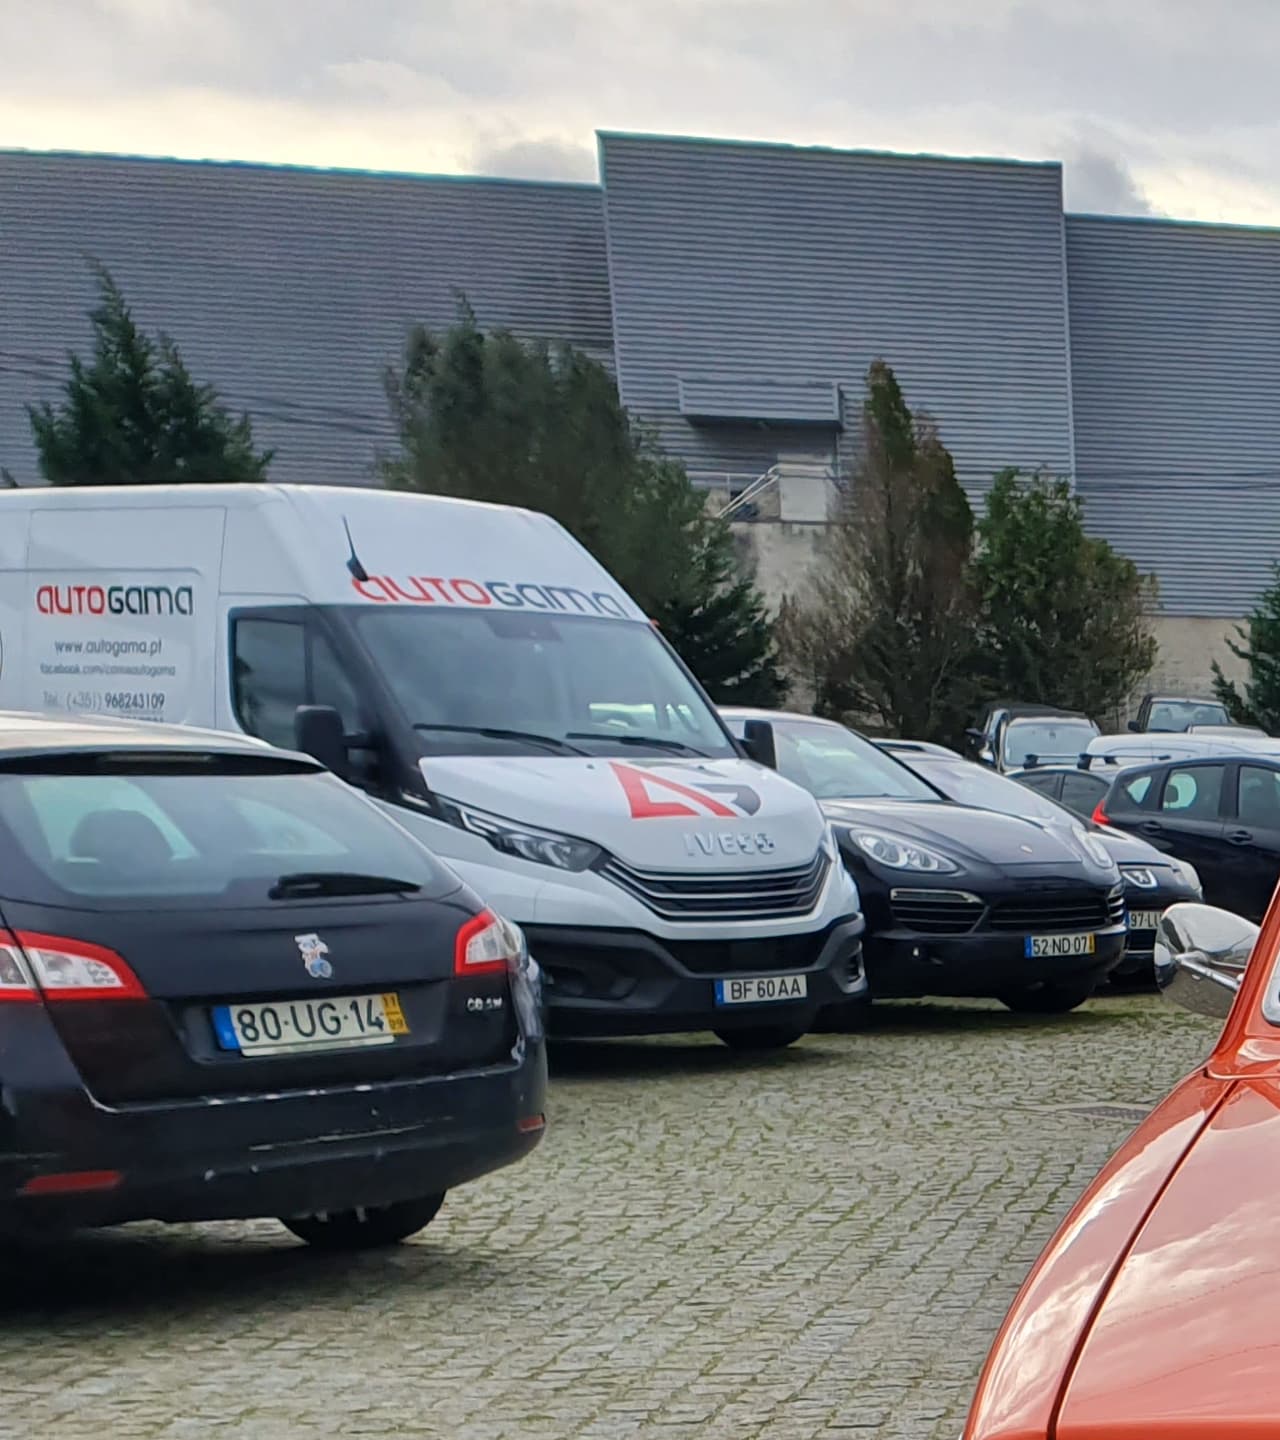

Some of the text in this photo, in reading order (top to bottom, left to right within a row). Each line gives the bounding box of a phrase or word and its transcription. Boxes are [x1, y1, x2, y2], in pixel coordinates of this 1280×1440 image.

[54, 640, 162, 657] www.autogama.pt
[104, 693, 165, 709] 968243109
[731, 977, 801, 1000] BF 60 AA
